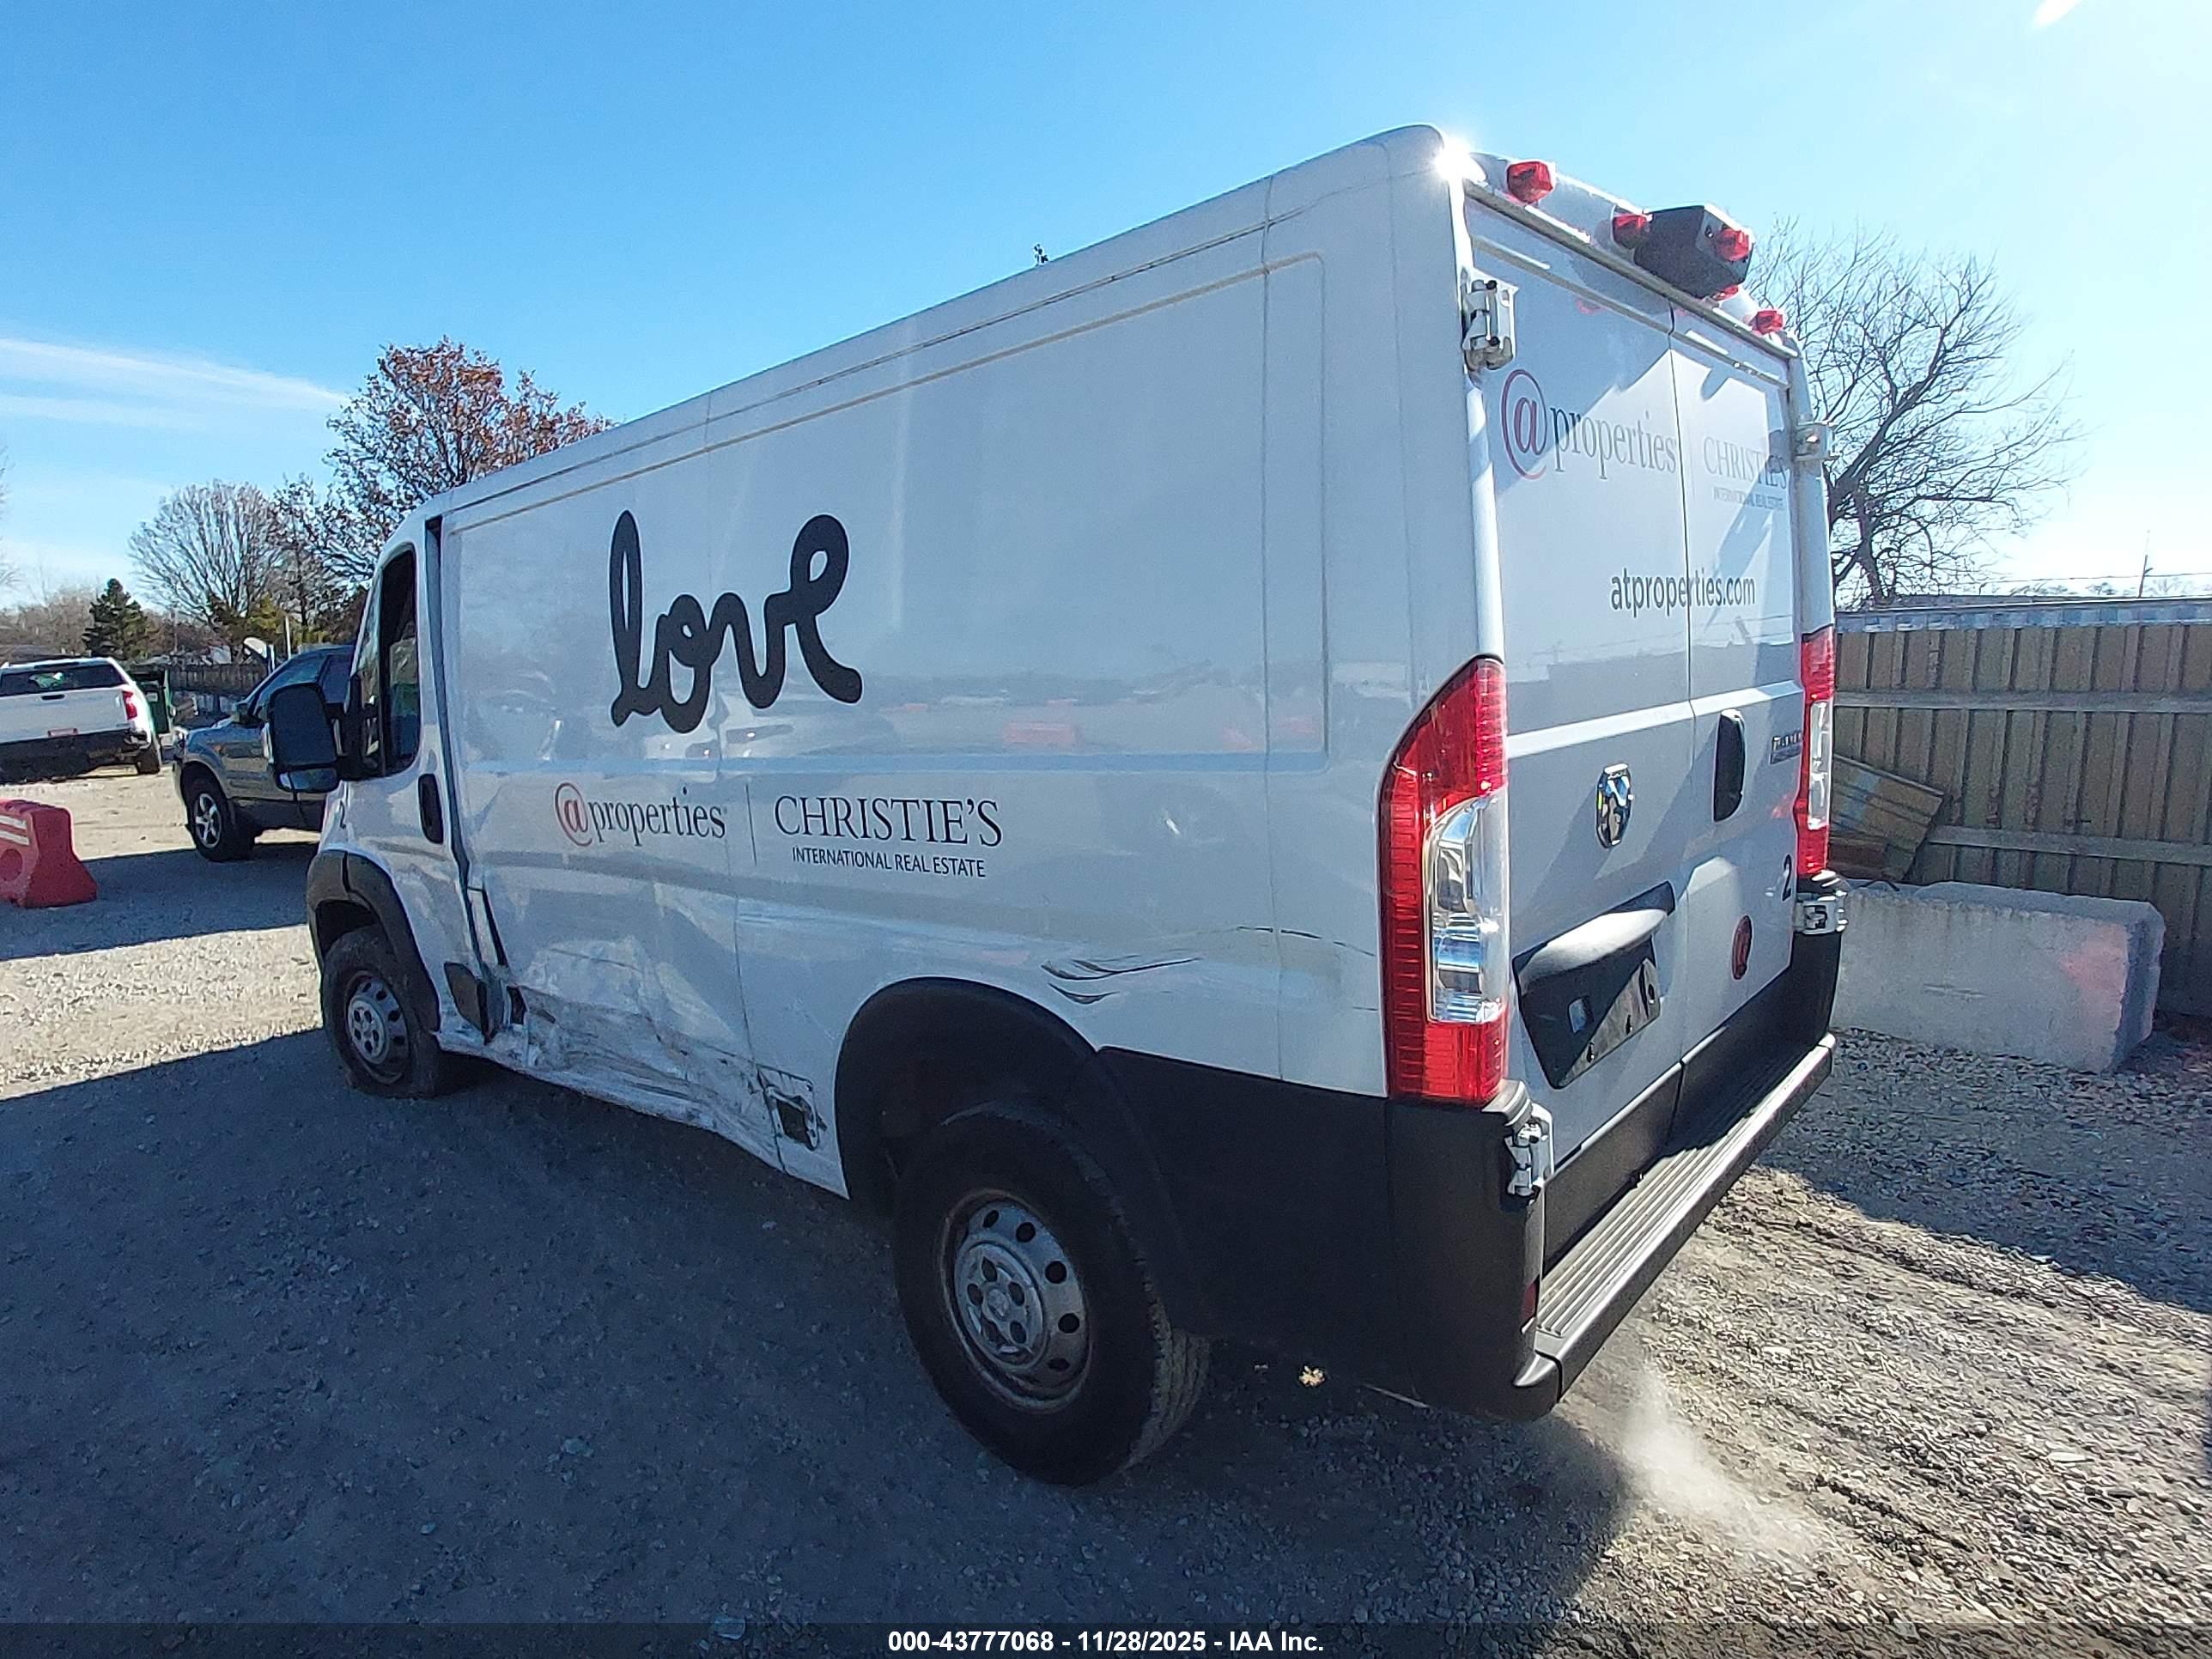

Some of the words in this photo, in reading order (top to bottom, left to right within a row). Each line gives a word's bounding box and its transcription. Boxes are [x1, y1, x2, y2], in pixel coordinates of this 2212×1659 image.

[1501, 369, 1675, 480] @properties
[1611, 568, 1755, 618] atproperties.com
[609, 509, 863, 733] love
[555, 782, 726, 847] @properties
[775, 795, 1003, 848] CHRISTIE'S
[792, 846, 893, 870] INTERNATIONAL
[895, 854, 931, 872] REAL
[933, 857, 986, 878] ESTATE
[1782, 854, 1792, 902] 2
